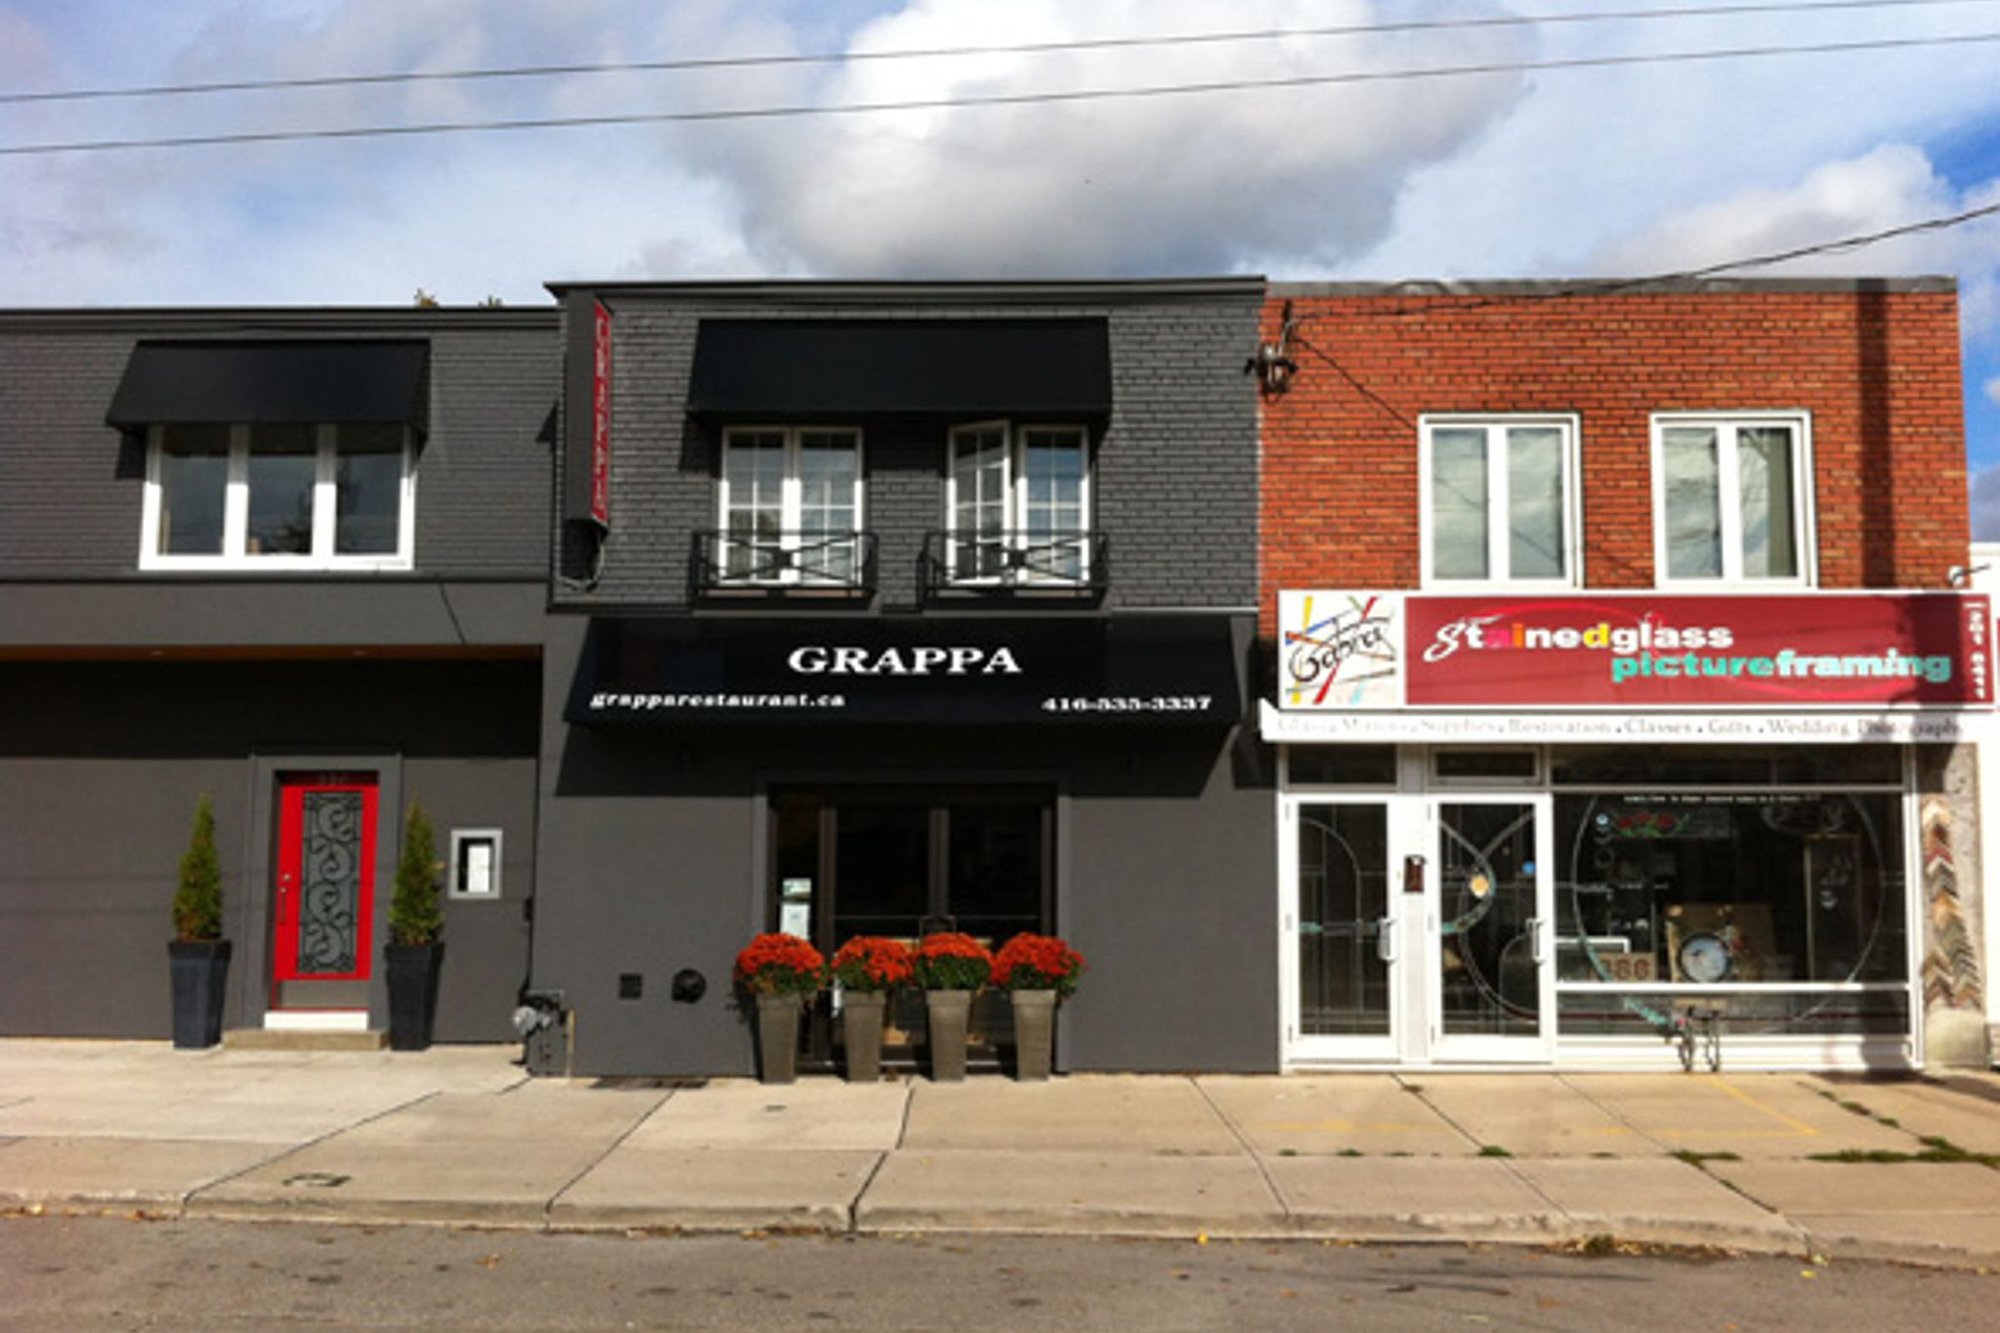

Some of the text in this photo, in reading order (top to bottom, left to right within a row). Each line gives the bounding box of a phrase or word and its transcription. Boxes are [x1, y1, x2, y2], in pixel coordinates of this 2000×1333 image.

[788, 647, 1023, 675] GRAPPA
[590, 692, 846, 709] grapparestaurant.ca
[1624, 717, 1692, 734] Classes
[1766, 718, 1850, 737] Wedding
